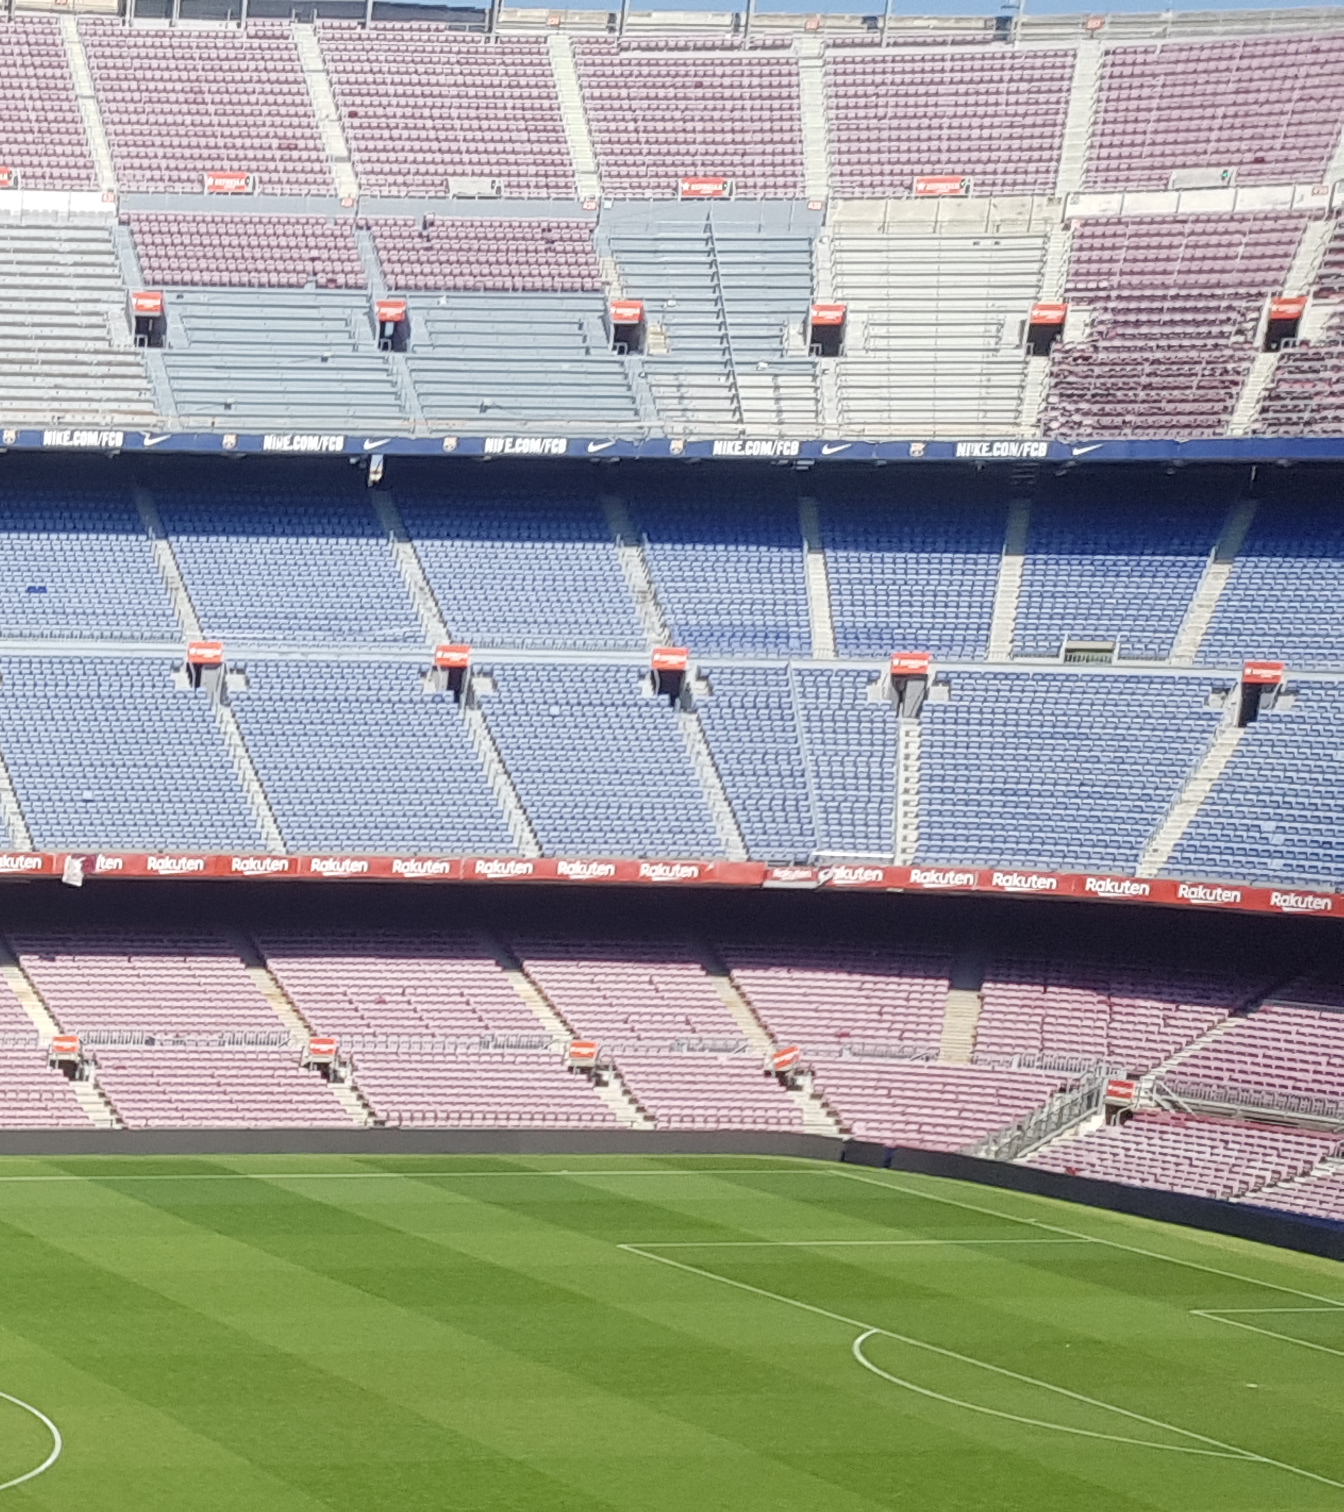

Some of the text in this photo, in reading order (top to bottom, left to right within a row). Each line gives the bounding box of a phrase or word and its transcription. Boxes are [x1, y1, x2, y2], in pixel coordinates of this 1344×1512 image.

[43, 430, 124, 447] NIKE.COM/FCB
[712, 440, 799, 456] NIKE.COM/FCB
[147, 857, 204, 871] Rakuten
[231, 858, 288, 872] Rakuten
[311, 858, 367, 872] Rakuten
[392, 859, 449, 874] Rakuten
[475, 860, 533, 874] Rakuten
[557, 861, 614, 876] Rakuten
[639, 863, 698, 878] Rakuten
[910, 869, 974, 884] Rakuten
[992, 872, 1057, 888] Rakuten
[1085, 877, 1150, 895] Rakuten
[1178, 882, 1241, 902] Rakuten
[1270, 892, 1332, 910] Rakuten
